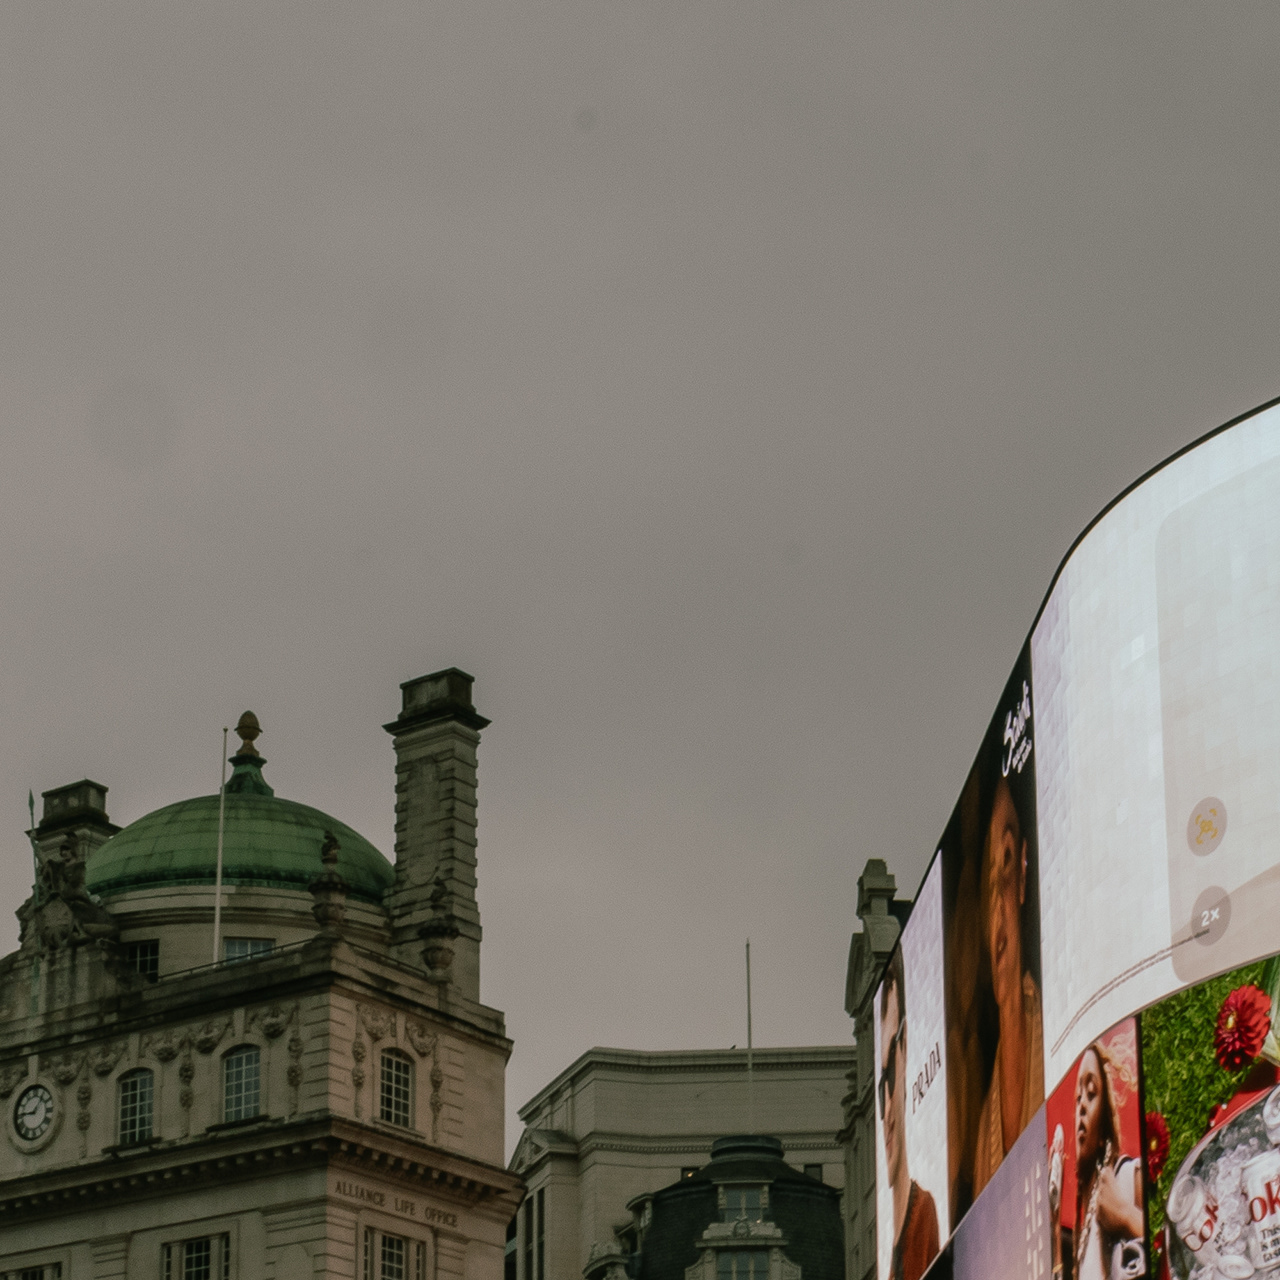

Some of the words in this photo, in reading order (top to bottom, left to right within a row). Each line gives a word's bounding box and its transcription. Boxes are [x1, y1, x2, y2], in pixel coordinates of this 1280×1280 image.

[912, 1041, 941, 1115] PRADA
[335, 1181, 386, 1208] ALLIANCE
[394, 1197, 416, 1216] LIFE
[425, 1206, 457, 1228] OFFICE
